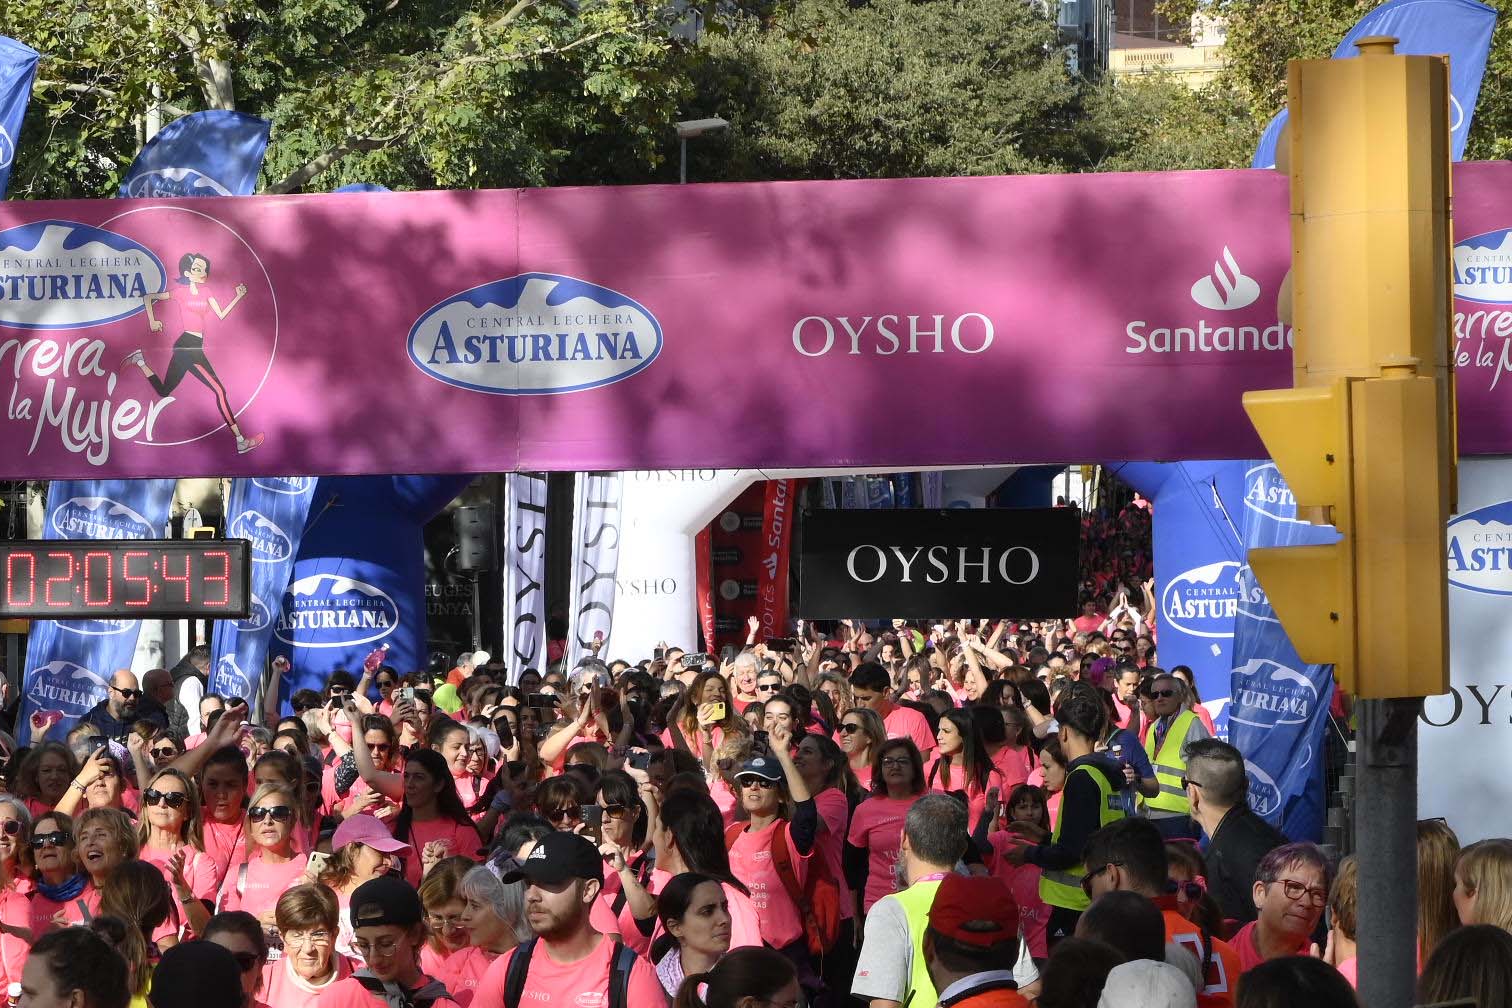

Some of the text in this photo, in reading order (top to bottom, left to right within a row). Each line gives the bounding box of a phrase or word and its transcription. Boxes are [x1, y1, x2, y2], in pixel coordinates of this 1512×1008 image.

[68, 256, 141, 268] LECHERA
[467, 313, 634, 328] CENTRAL LECHERA
[792, 312, 994, 357] OYSHO
[427, 320, 642, 365] ASTURIANA
[8, 386, 33, 421] la
[28, 371, 177, 465] Mujer
[7, 552, 229, 605] 02:05:43
[846, 545, 1040, 585] OYSHO
[1186, 588, 1235, 596] CENTRAL
[276, 609, 390, 632] ASTURIANA
